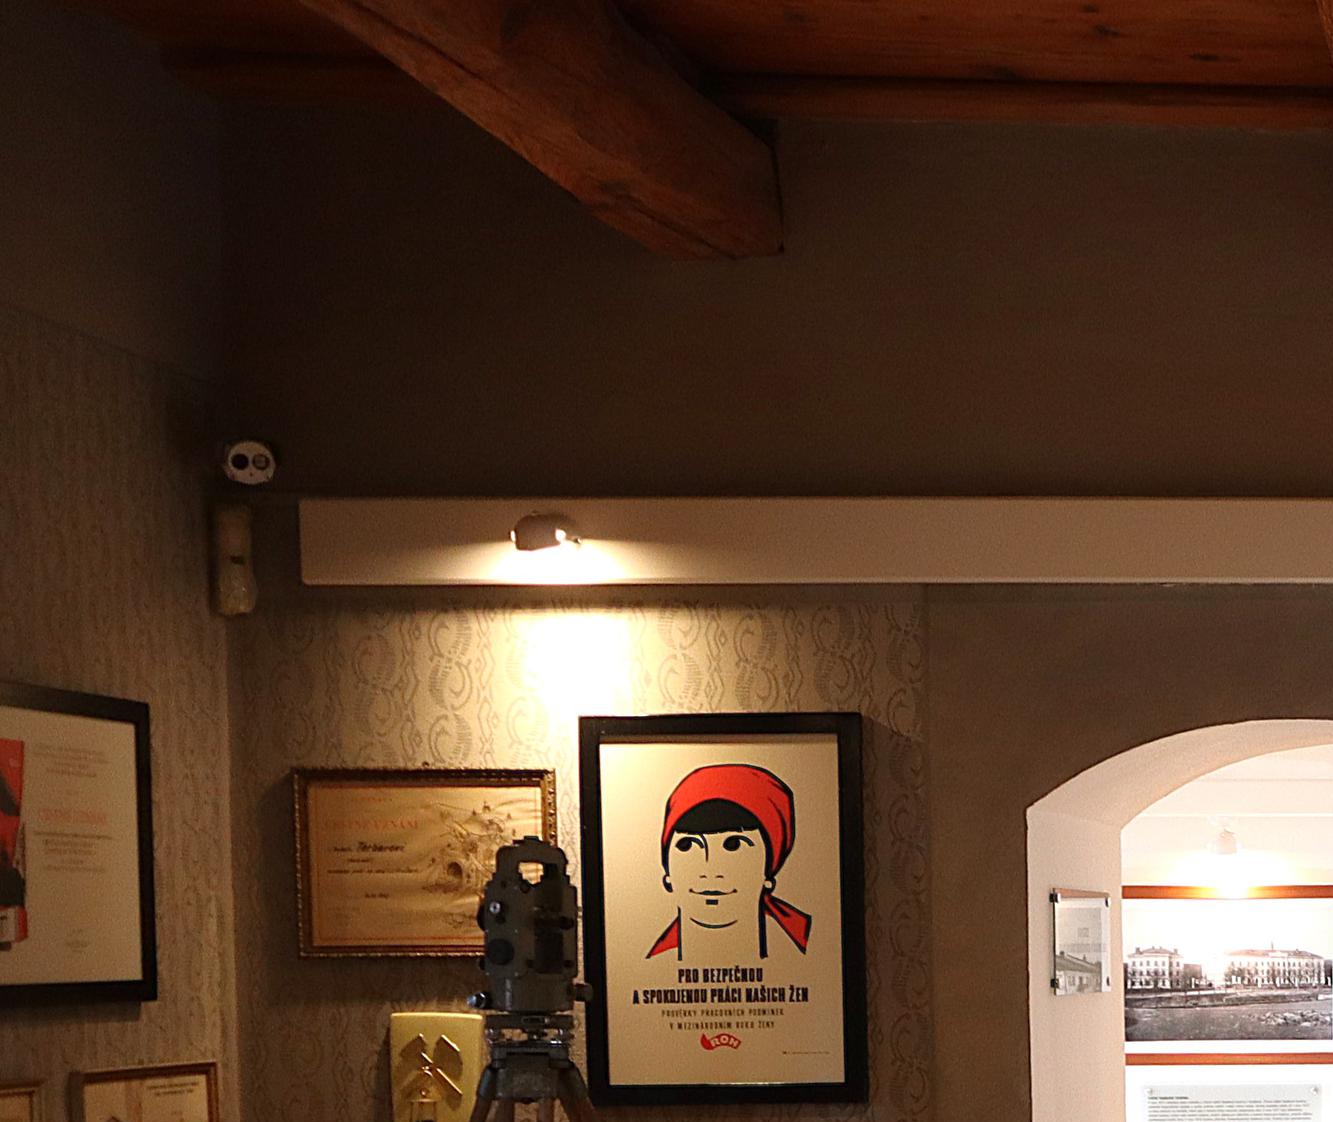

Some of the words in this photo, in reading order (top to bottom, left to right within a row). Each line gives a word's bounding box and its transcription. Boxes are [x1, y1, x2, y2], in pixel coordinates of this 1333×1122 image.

[678, 968, 699, 984] PRO
[702, 965, 764, 984] BEZPEČNOU
[632, 989, 640, 1005] A
[643, 988, 708, 1004] SPOKOJENOU
[711, 986, 742, 1003] PRÁCI
[745, 984, 786, 1003] NAŠICH
[789, 984, 809, 1003] ŽEN
[710, 1035, 739, 1048] ROH
